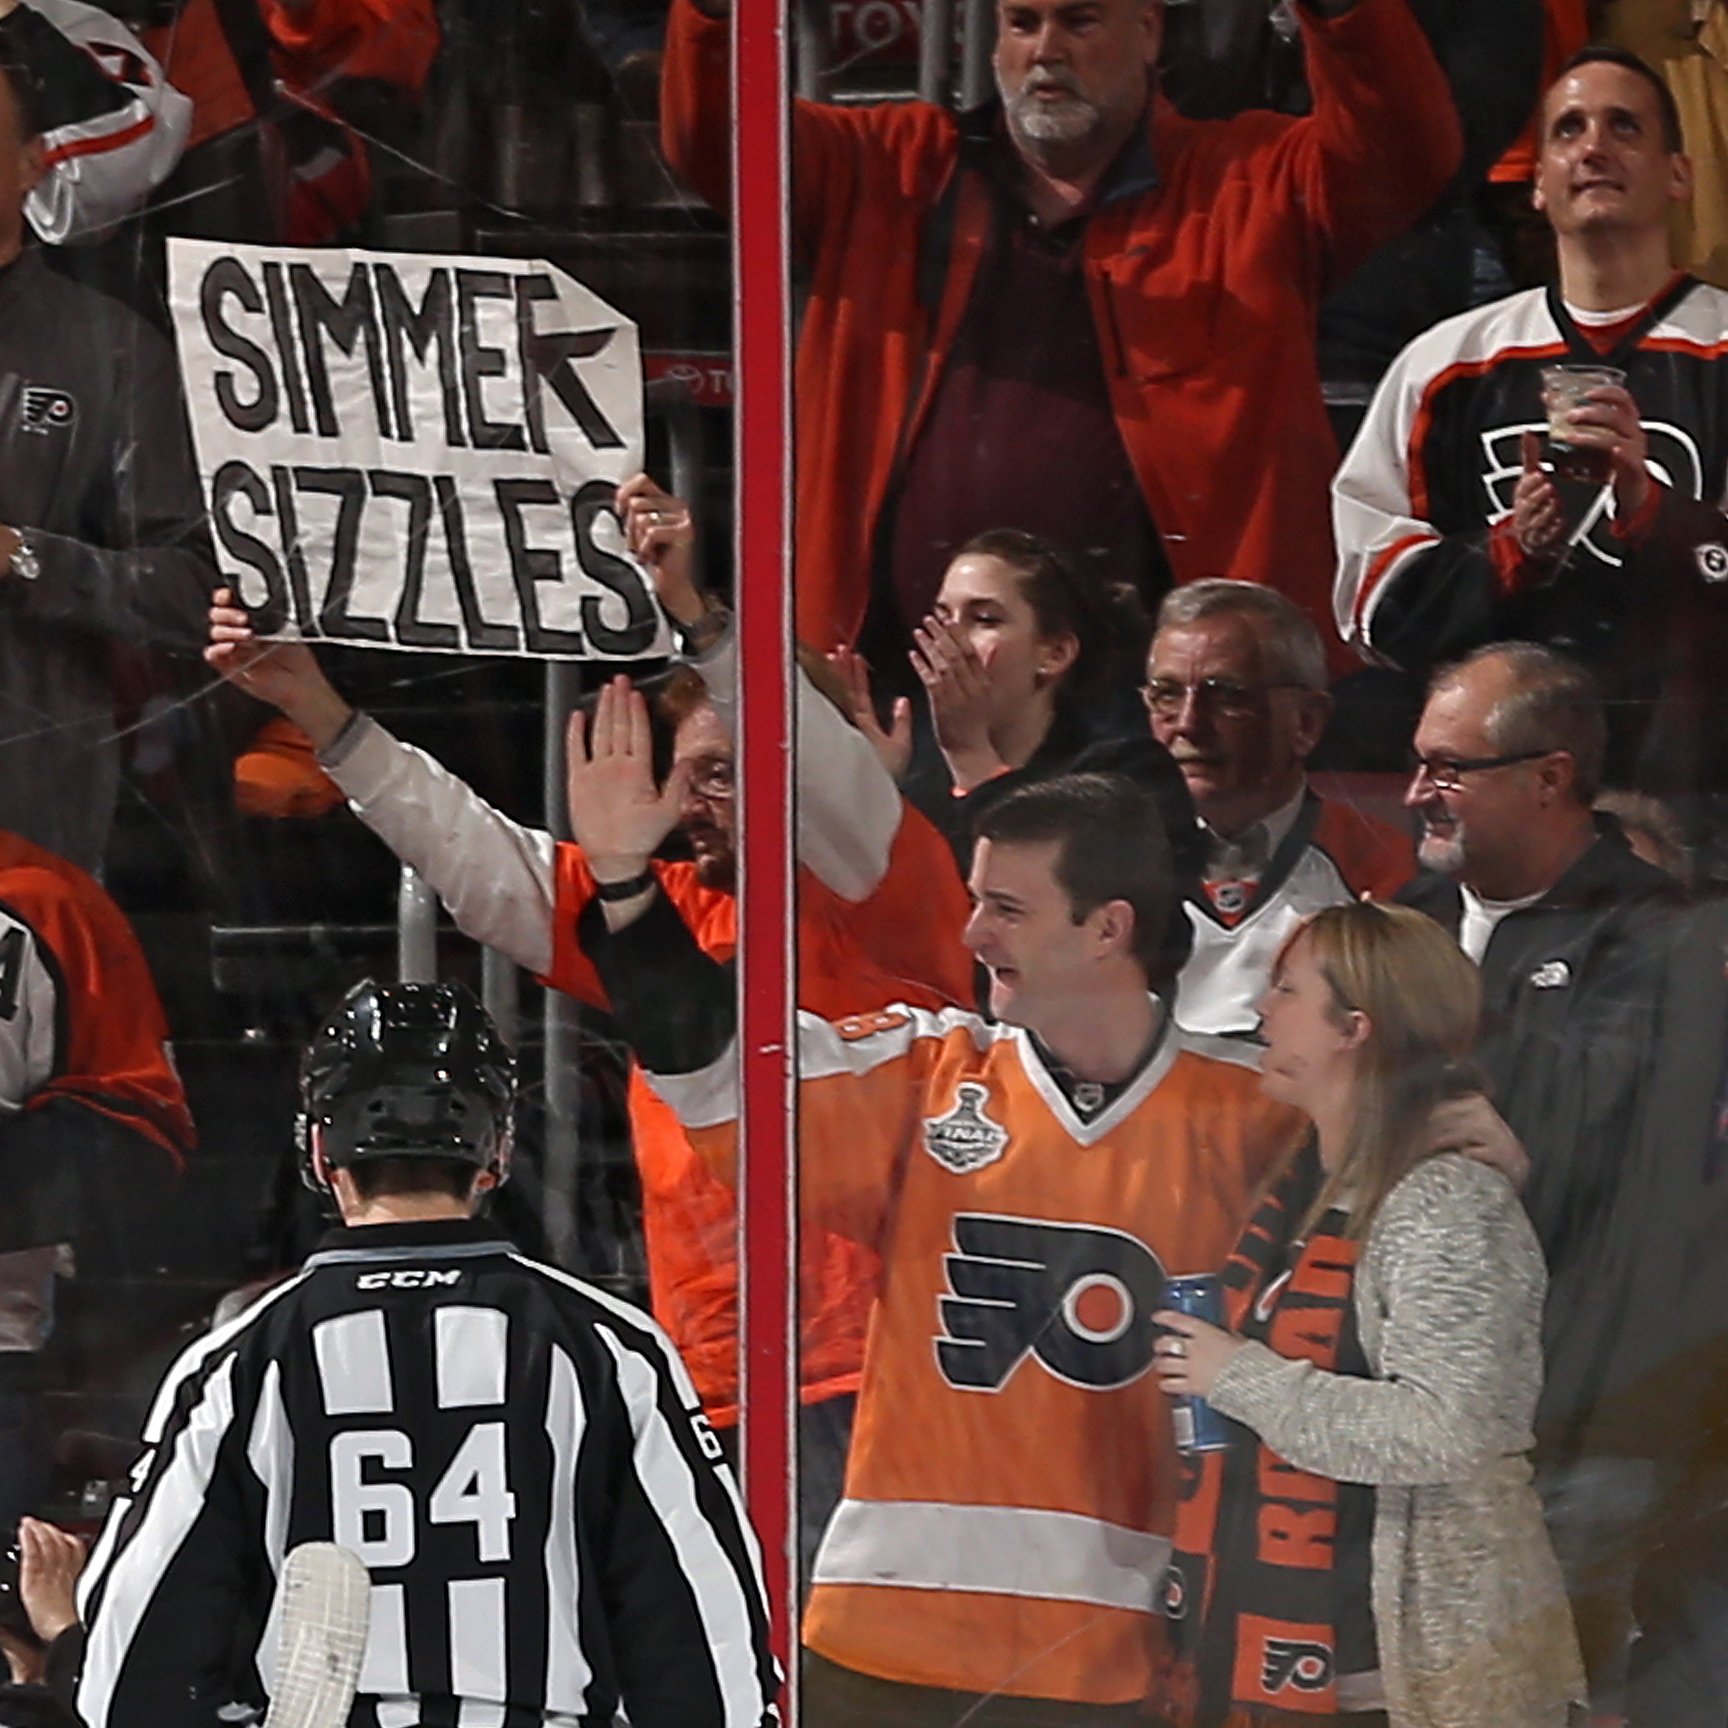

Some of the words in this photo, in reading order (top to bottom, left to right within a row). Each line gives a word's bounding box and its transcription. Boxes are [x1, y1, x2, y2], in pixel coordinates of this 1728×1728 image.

[200, 255, 628, 456] SIMMER
[211, 460, 658, 656] SIZZLES
[356, 1269, 463, 1291] CCM
[330, 1421, 517, 1569] 64
